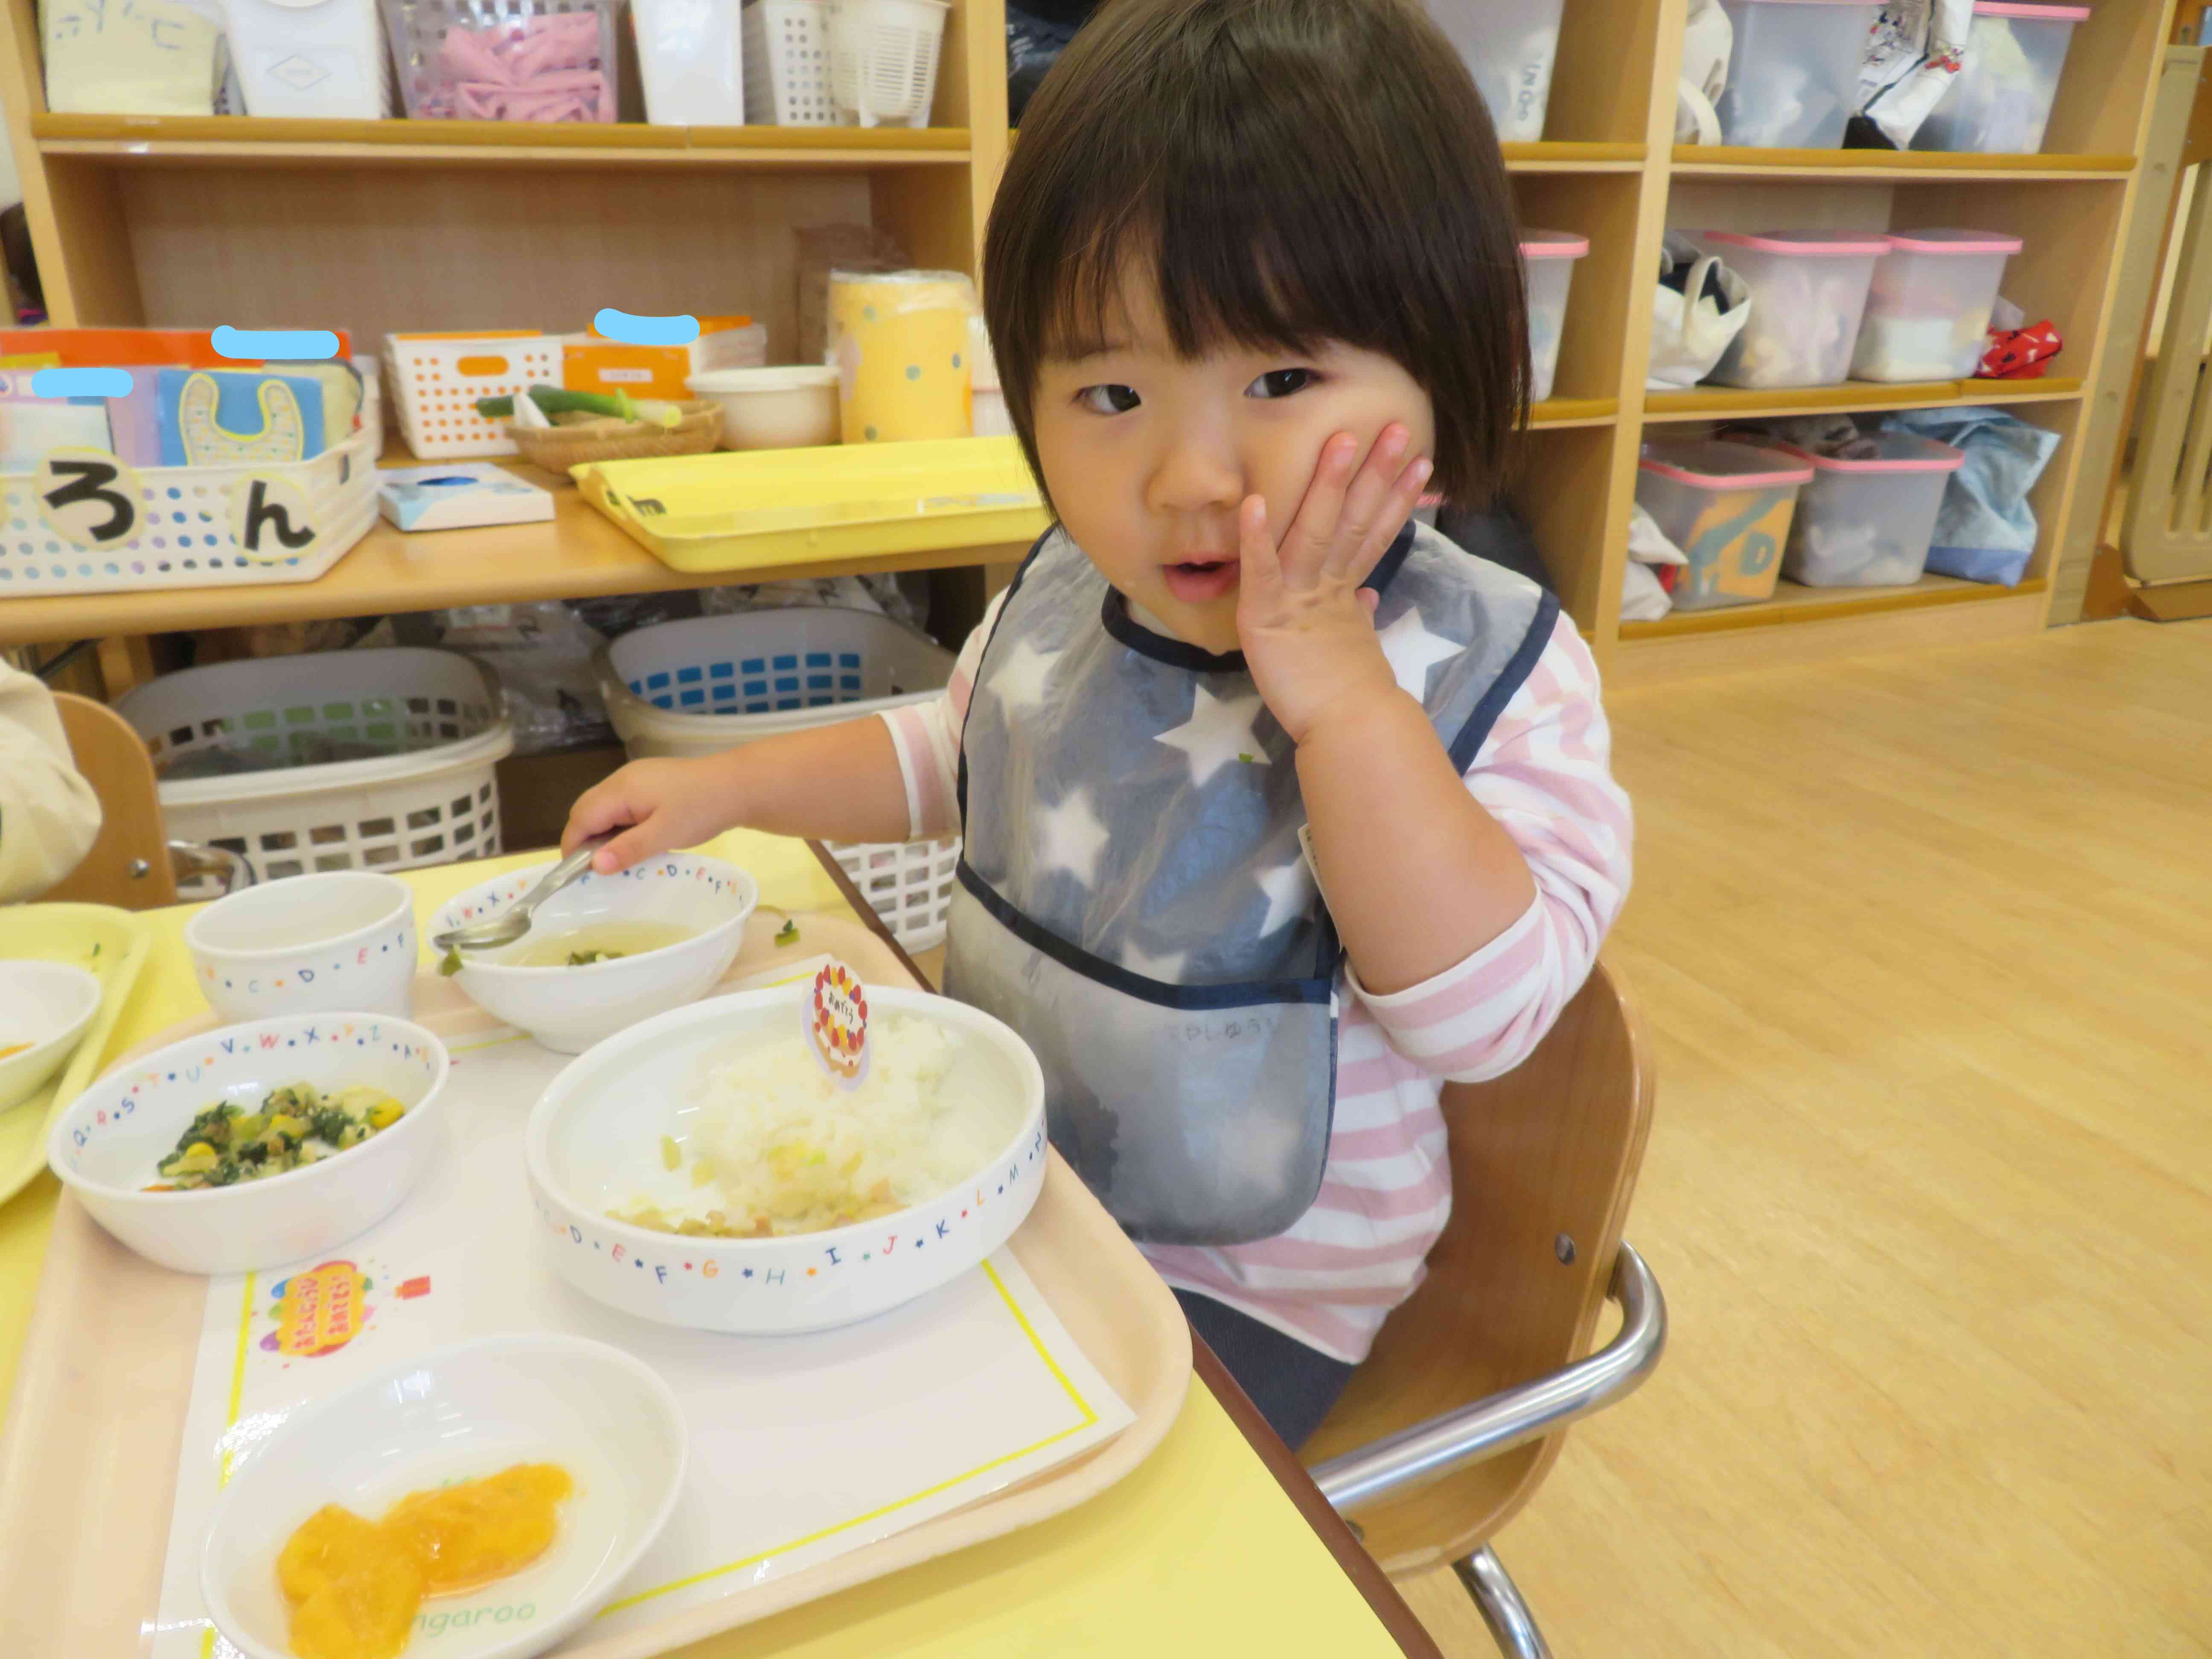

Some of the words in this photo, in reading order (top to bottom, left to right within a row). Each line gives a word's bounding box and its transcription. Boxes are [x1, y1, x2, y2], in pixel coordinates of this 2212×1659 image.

[43, 460, 134, 542] ろ
[244, 480, 315, 551] ん
[636, 867, 645, 880] C
[667, 864, 677, 877] D
[247, 980, 260, 994] C
[298, 969, 314, 983] D
[357, 946, 369, 965] E
[121, 1097, 135, 1114] S
[219, 1037, 233, 1054] V
[259, 1033, 280, 1049] W
[303, 1026, 320, 1045] X
[569, 1224, 582, 1243] D
[612, 1243, 626, 1263] E
[655, 1265, 667, 1284] F
[703, 1258, 719, 1278] G
[765, 1268, 786, 1286] H
[826, 1247, 841, 1265] I
[883, 1235, 898, 1254] J
[935, 1219, 950, 1238] K
[976, 1187, 987, 1206] L
[1010, 1163, 1019, 1185] M
[412, 1602, 537, 1638] ngaroo
